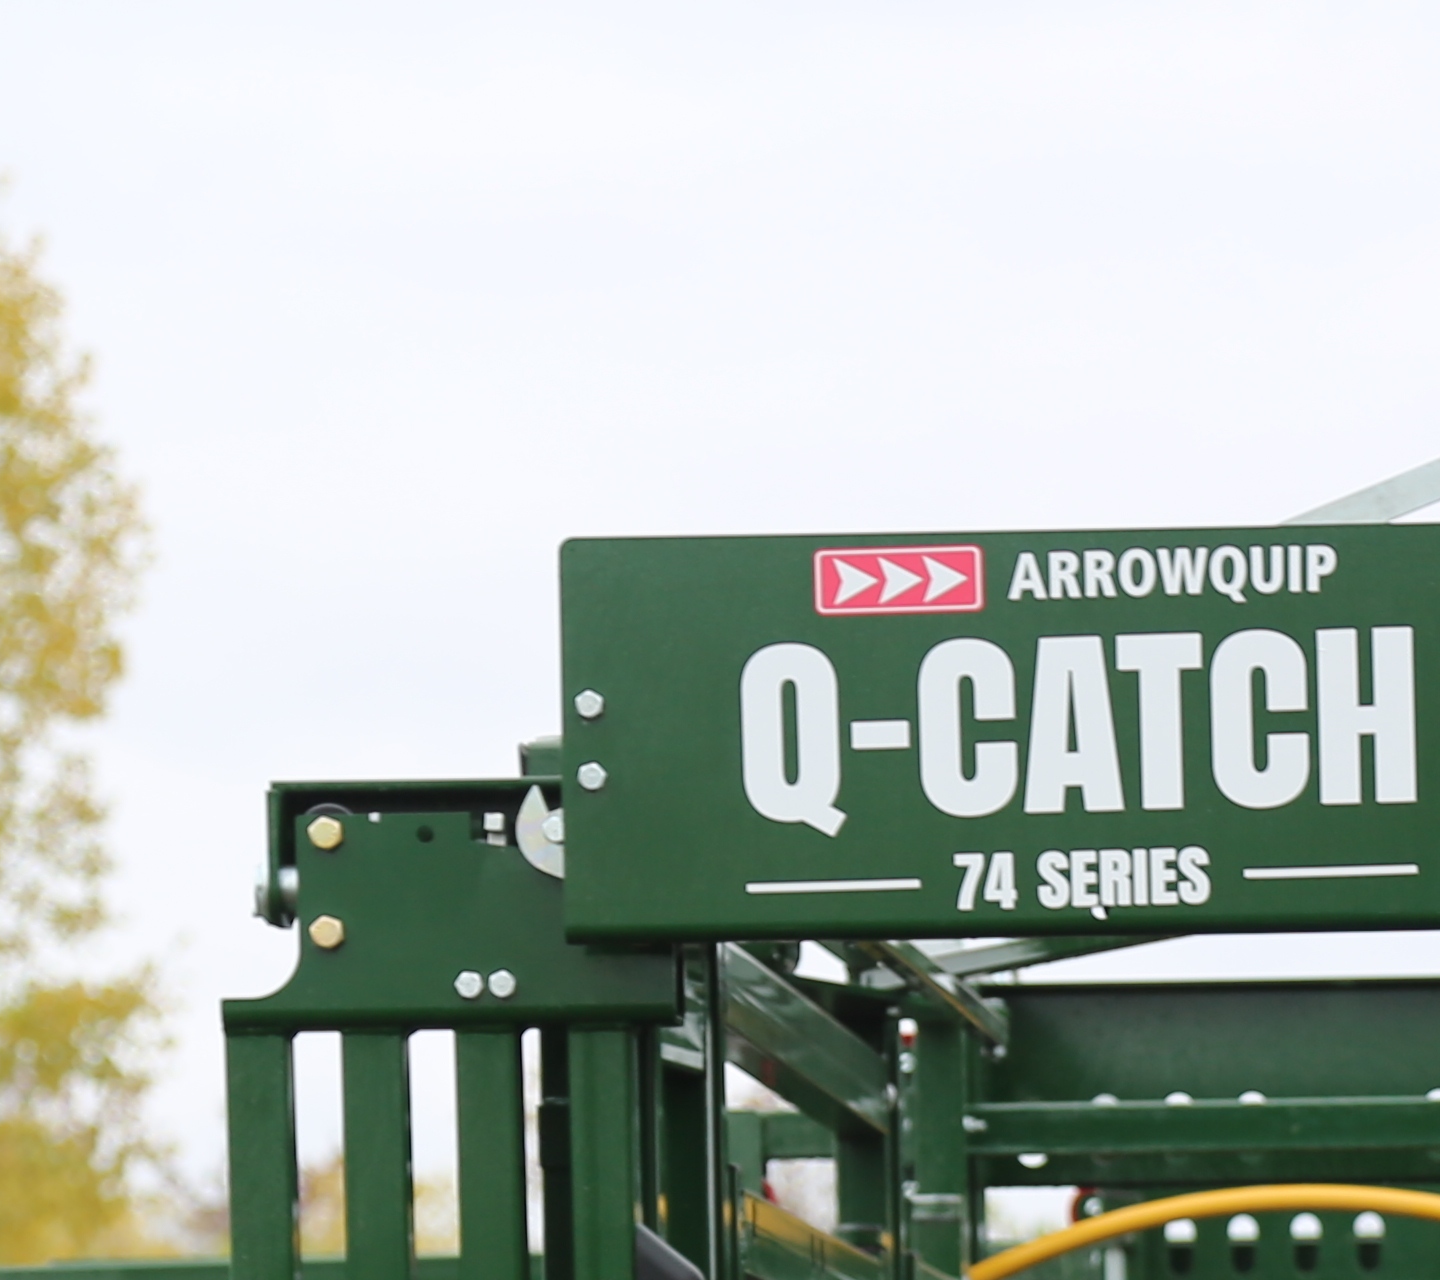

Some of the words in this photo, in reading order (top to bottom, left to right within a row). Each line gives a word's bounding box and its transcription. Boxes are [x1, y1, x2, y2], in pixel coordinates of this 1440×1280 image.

[1008, 545, 1338, 604] ARROWQUIP
[740, 626, 1418, 837] Q-CATCH
[953, 852, 1019, 911] 74
[1037, 846, 1212, 911] SERIES
